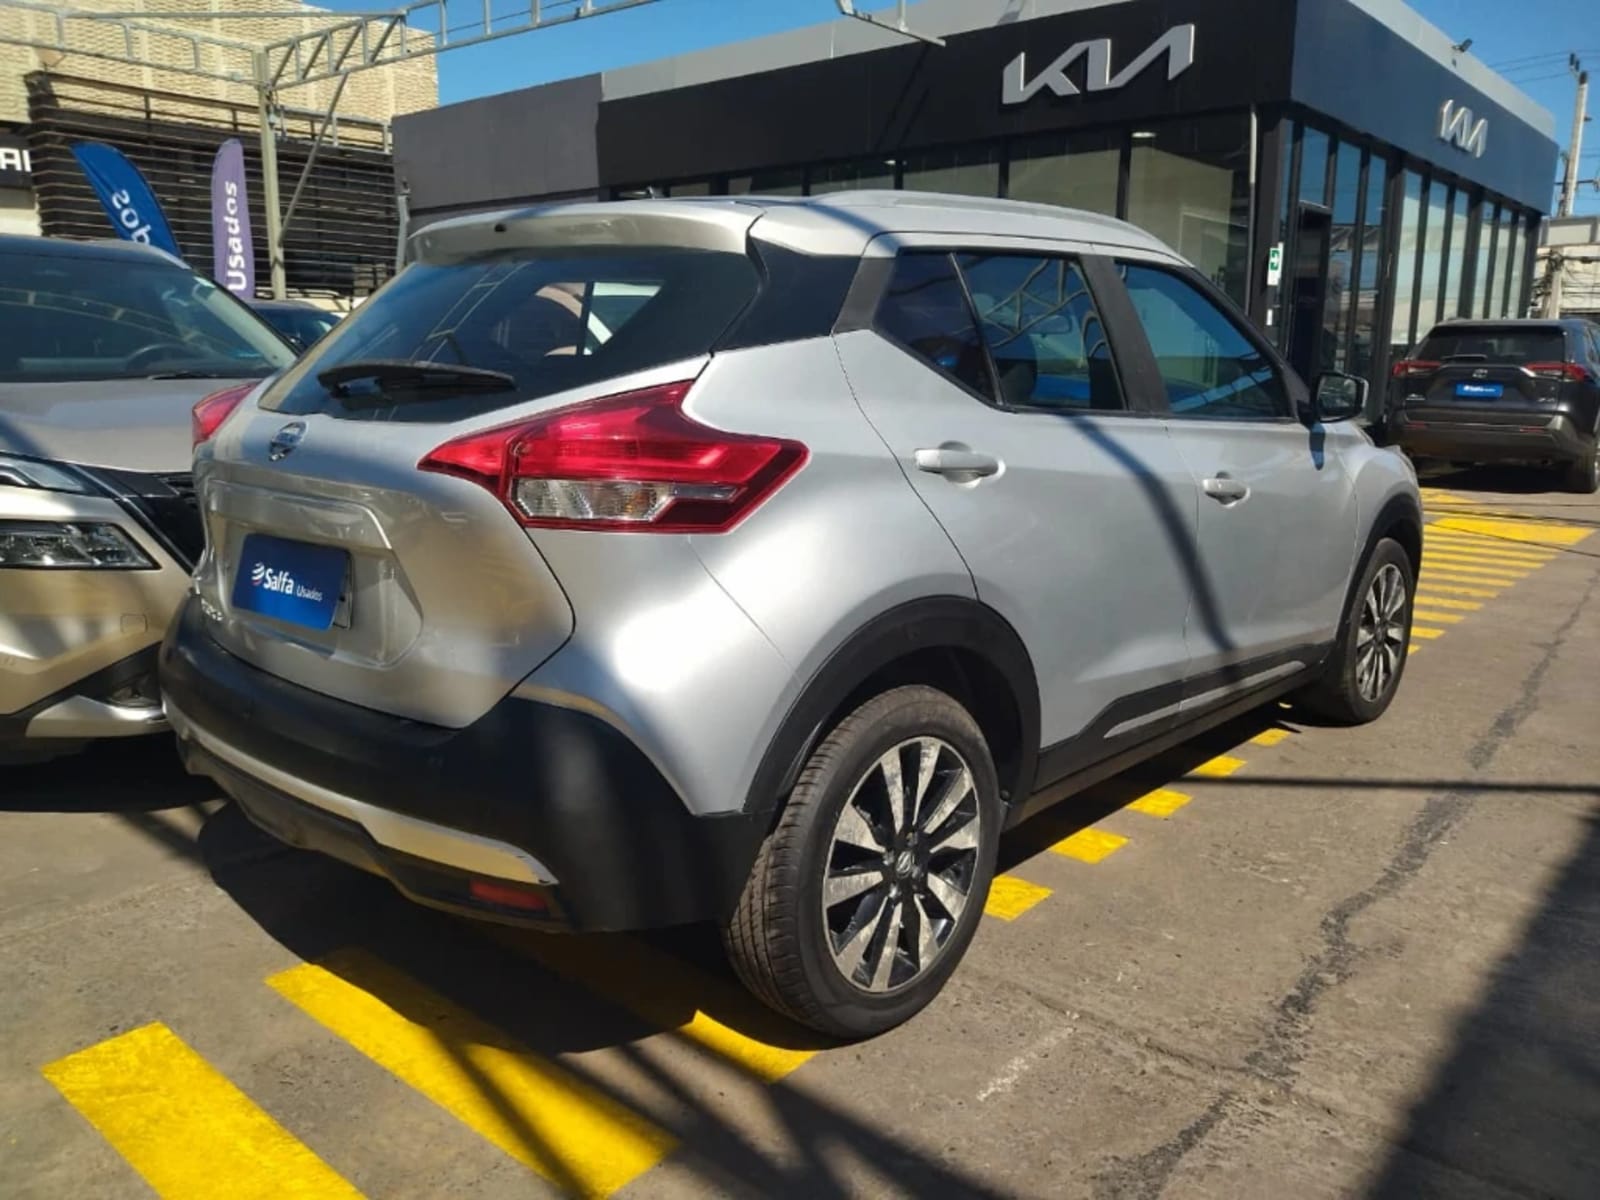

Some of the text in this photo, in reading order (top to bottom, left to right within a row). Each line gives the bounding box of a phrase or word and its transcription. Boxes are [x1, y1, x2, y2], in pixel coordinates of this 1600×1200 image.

[1002, 23, 1195, 105] KIA
[1440, 99, 1488, 158] KIA
[224, 181, 247, 291] Usados
[263, 568, 323, 602] Salfa Usados
